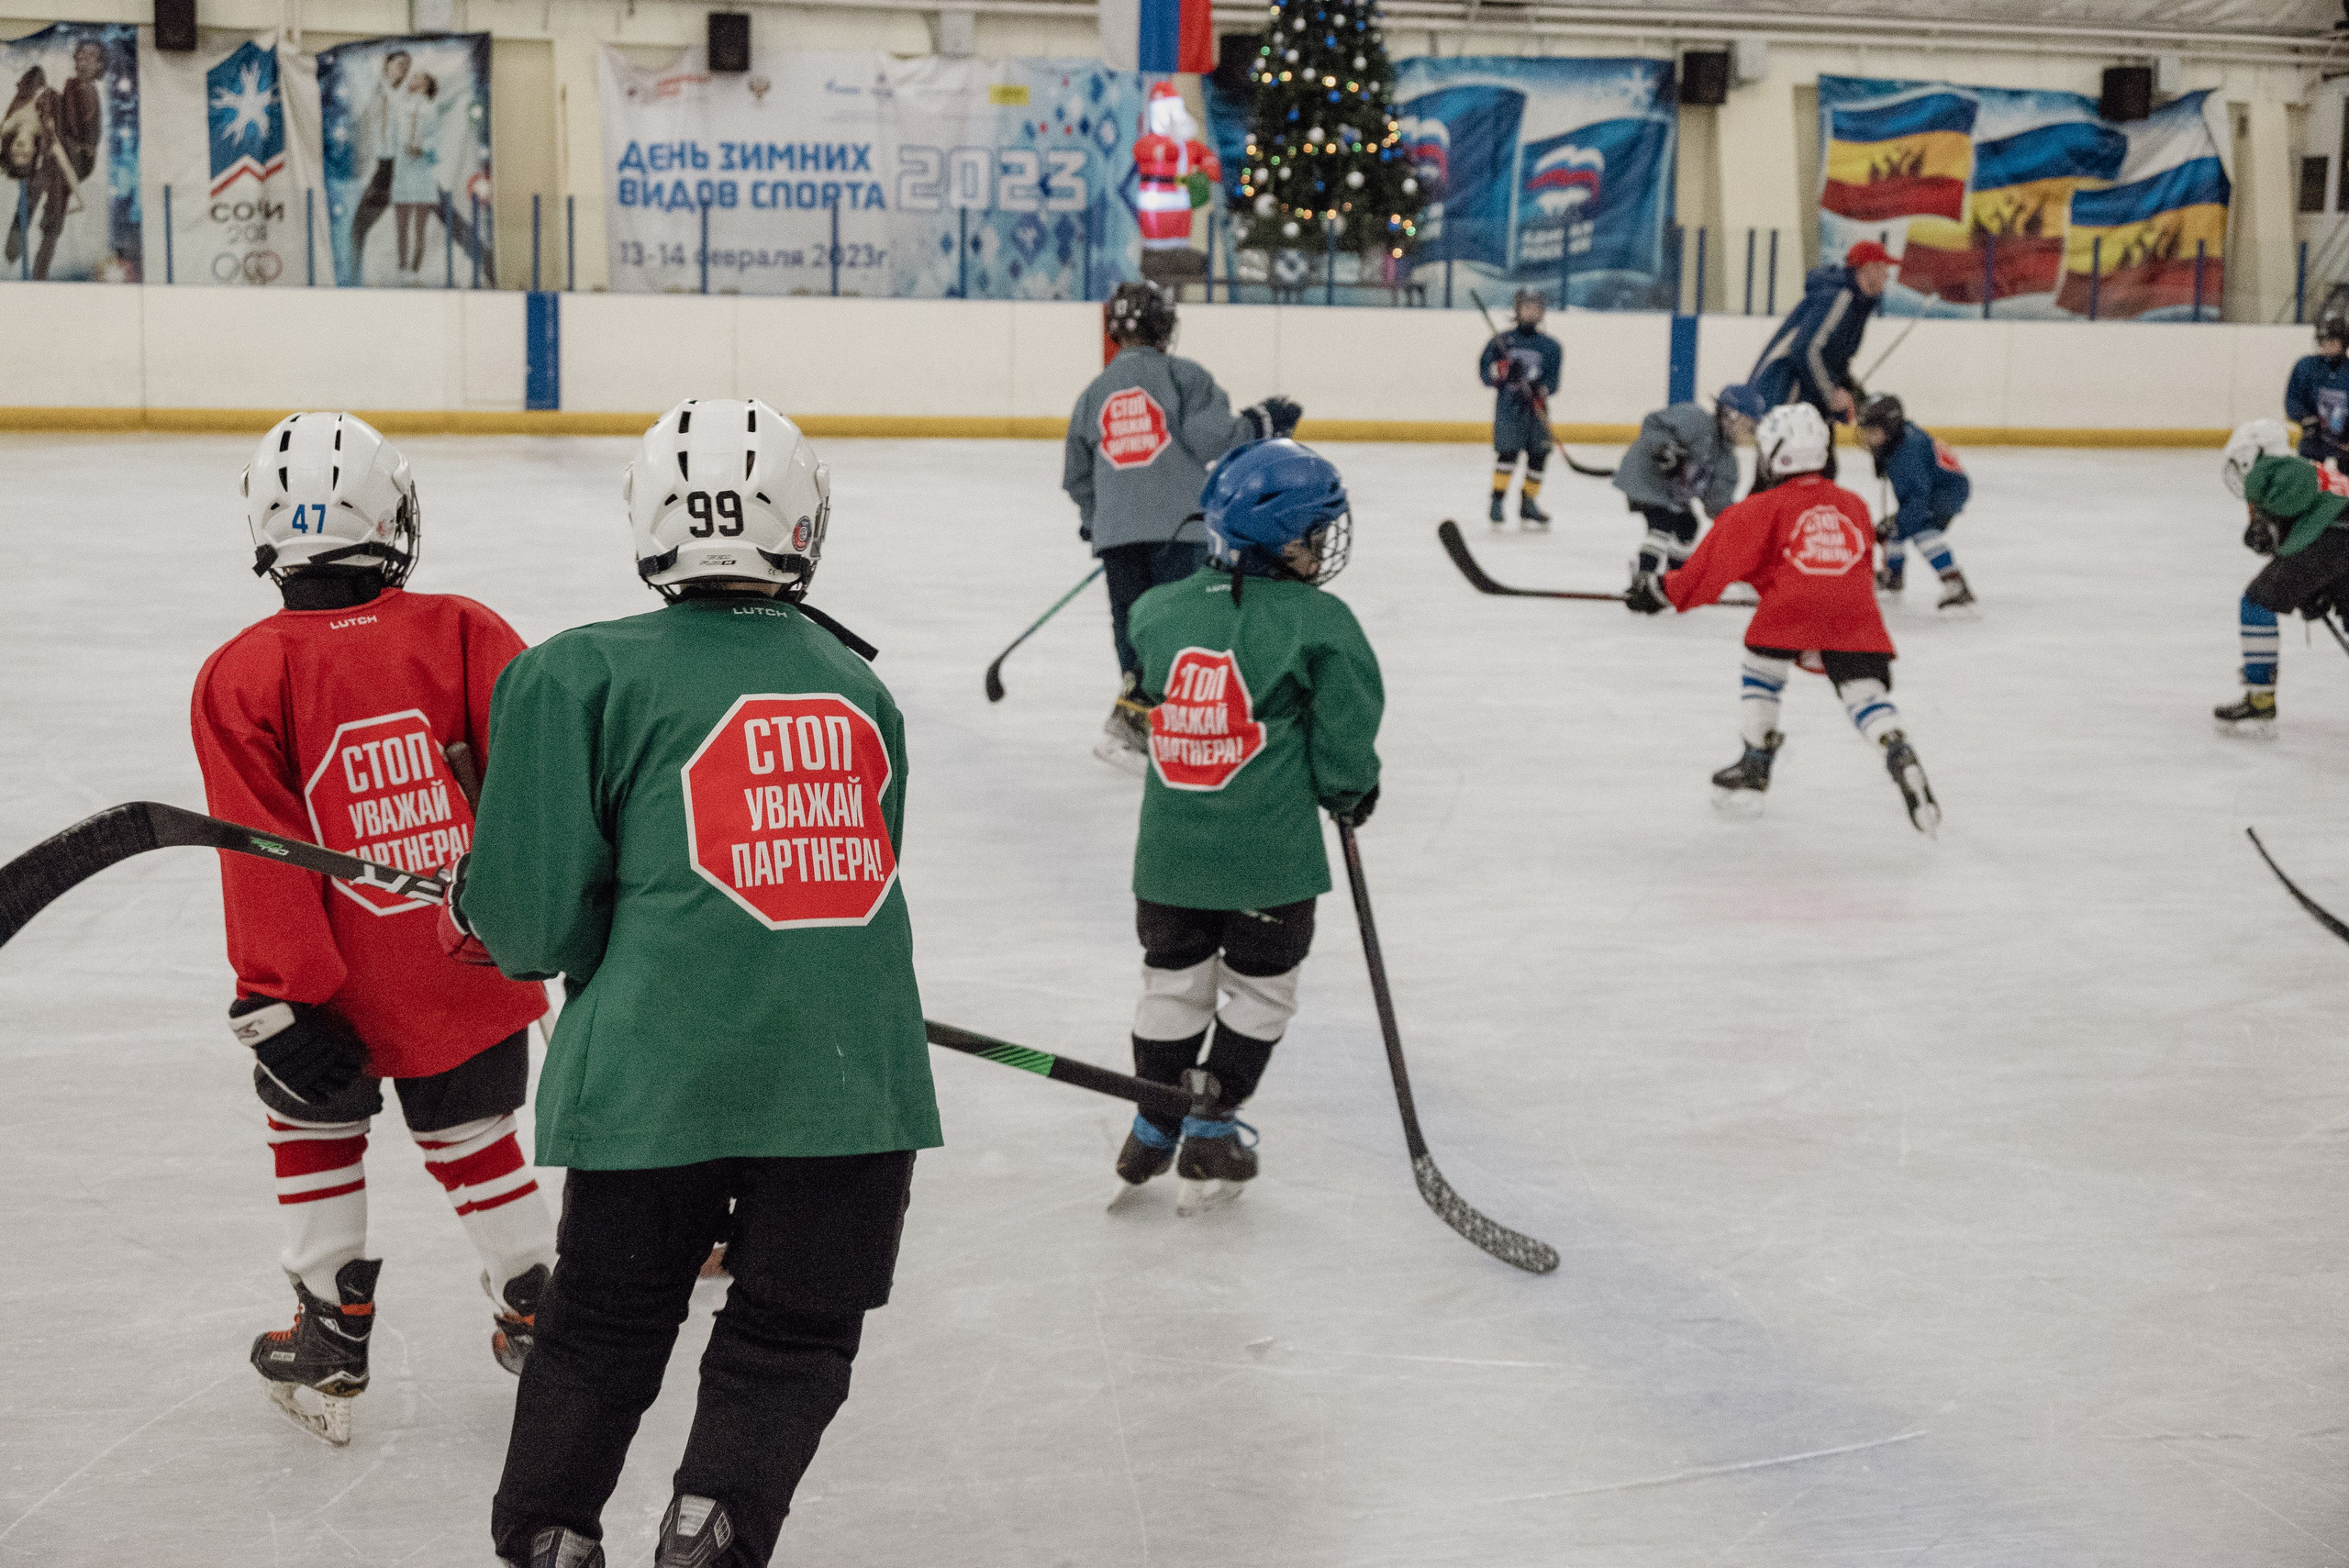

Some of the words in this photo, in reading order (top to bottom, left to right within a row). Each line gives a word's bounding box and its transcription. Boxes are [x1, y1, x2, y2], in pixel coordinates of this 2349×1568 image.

[618, 139, 710, 173] ДЕНЬ
[718, 141, 871, 172] ЗИМНИХ
[896, 144, 1086, 213] 2023
[618, 177, 739, 214] ВИДОВ
[751, 180, 886, 211] СПОРТА
[292, 504, 326, 534] 47
[687, 490, 744, 539] 99
[329, 615, 378, 630] LUTCH
[733, 606, 788, 618] LUTCH
[1171, 662, 1229, 703] ТОП
[341, 731, 435, 795] СТОП
[744, 716, 852, 775] СТОП
[349, 779, 452, 840] УВАЖАЙ
[744, 775, 865, 832] УВАЖАЙ
[345, 823, 470, 873] АРТНЕРА!
[731, 837, 885, 889] ПАРТНЕРА!
